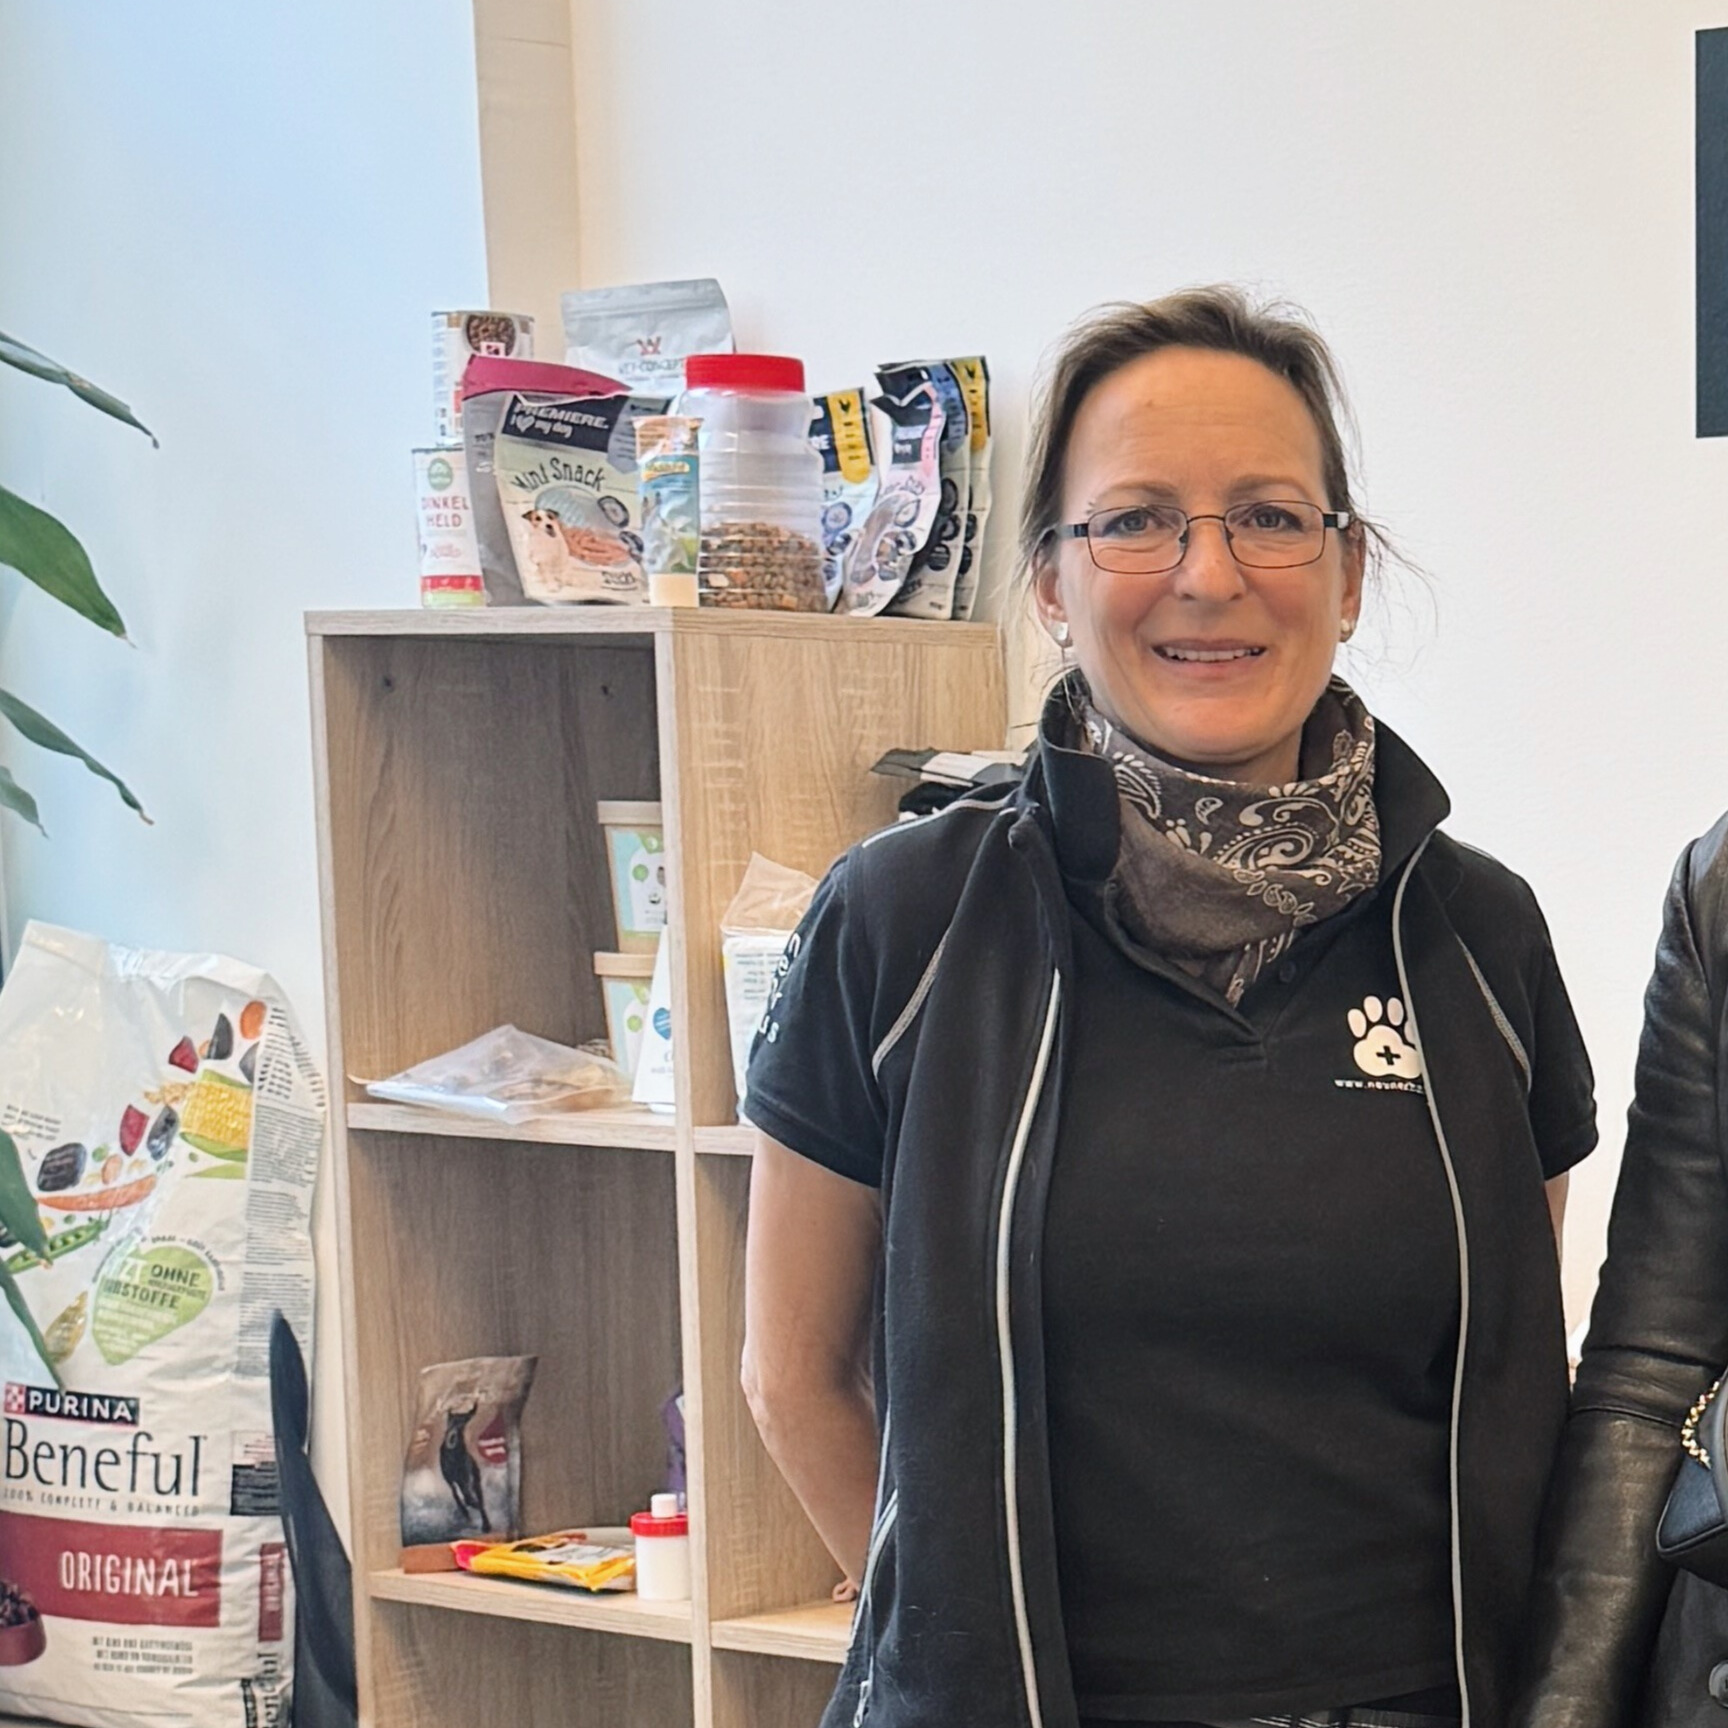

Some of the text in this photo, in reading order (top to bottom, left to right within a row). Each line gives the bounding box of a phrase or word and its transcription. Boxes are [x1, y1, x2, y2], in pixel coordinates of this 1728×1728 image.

[549, 456, 606, 492] Snack
[426, 512, 463, 528] HELD
[150, 1263, 202, 1288] OHNE
[29, 1389, 133, 1422] PURINA
[4, 1417, 202, 1497] Beneful
[41, 1491, 100, 1511] COMPLETE
[127, 1503, 201, 1517] BALANCED
[60, 1549, 201, 1598] ORIGINAL
